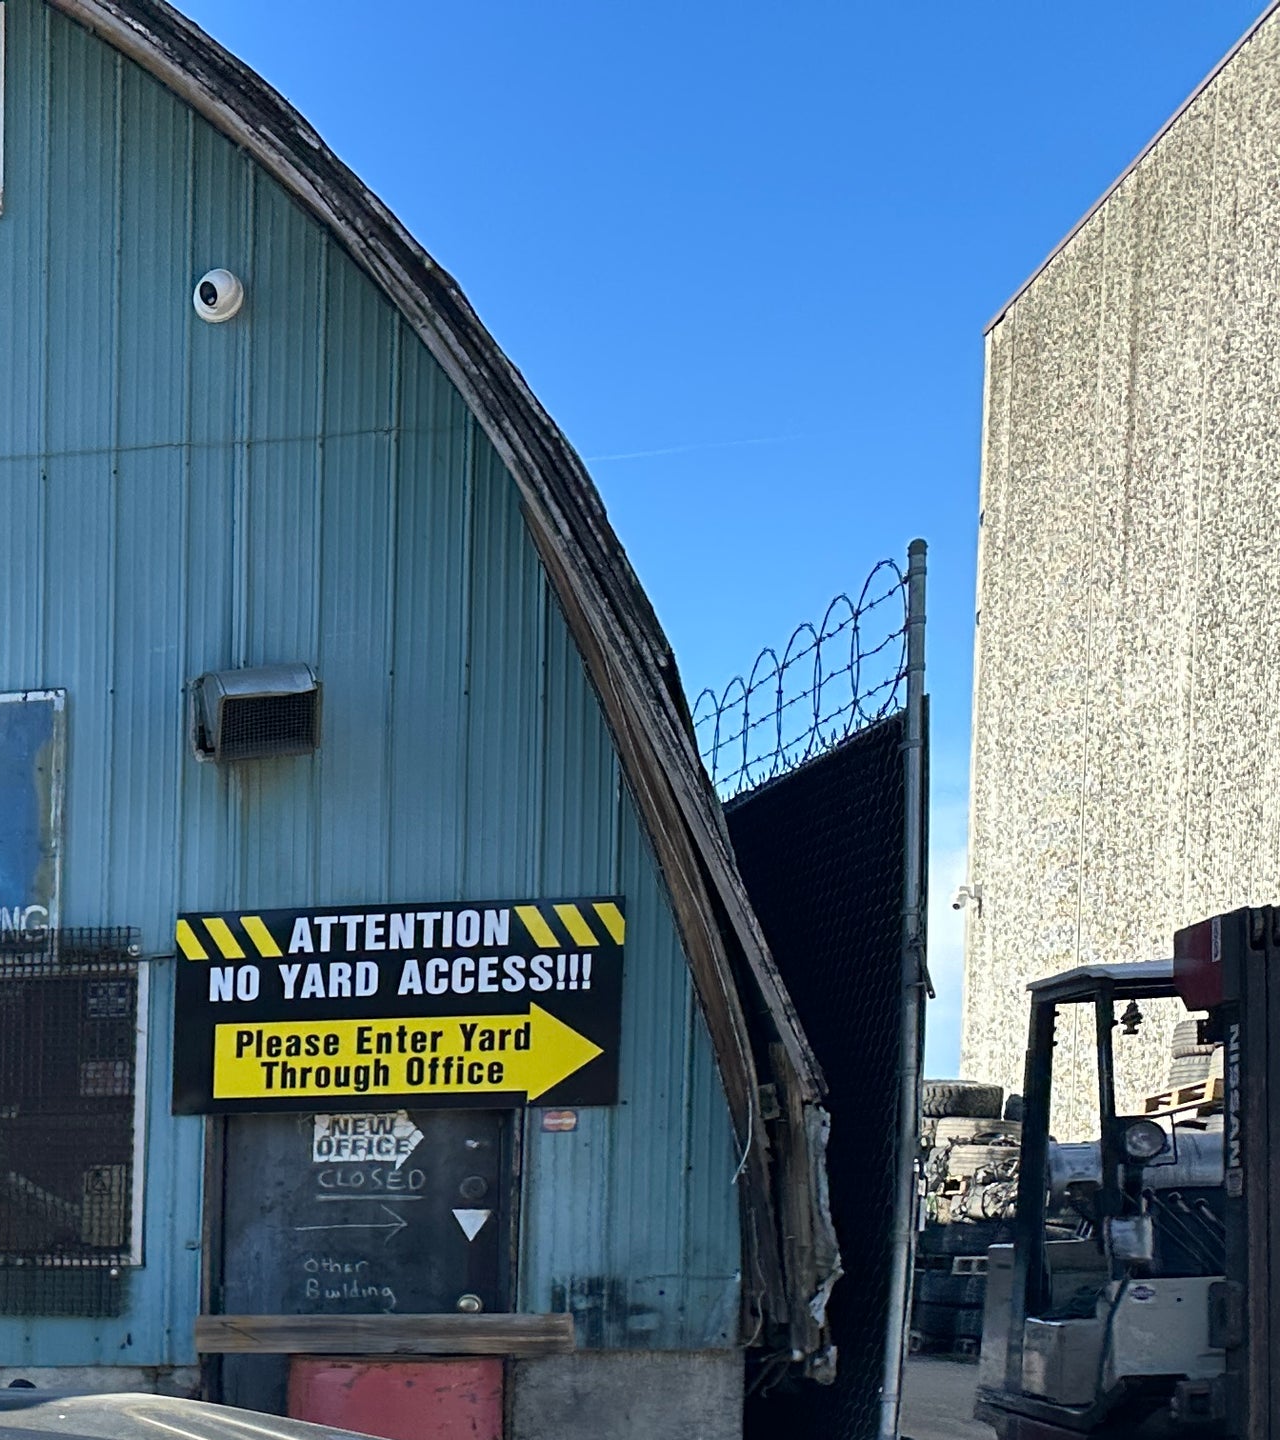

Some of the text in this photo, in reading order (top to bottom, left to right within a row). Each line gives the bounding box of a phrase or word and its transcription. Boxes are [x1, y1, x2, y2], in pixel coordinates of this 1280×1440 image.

[287, 908, 511, 955] ATTENTION
[208, 953, 593, 1002] NO YARD ACCESS!!!
[236, 1021, 532, 1060] Please Enter Yard
[260, 1055, 505, 1093] Through Office
[329, 1117, 395, 1136] NEW
[317, 1135, 412, 1157] OFFICE
[318, 1167, 427, 1191] CLOSED
